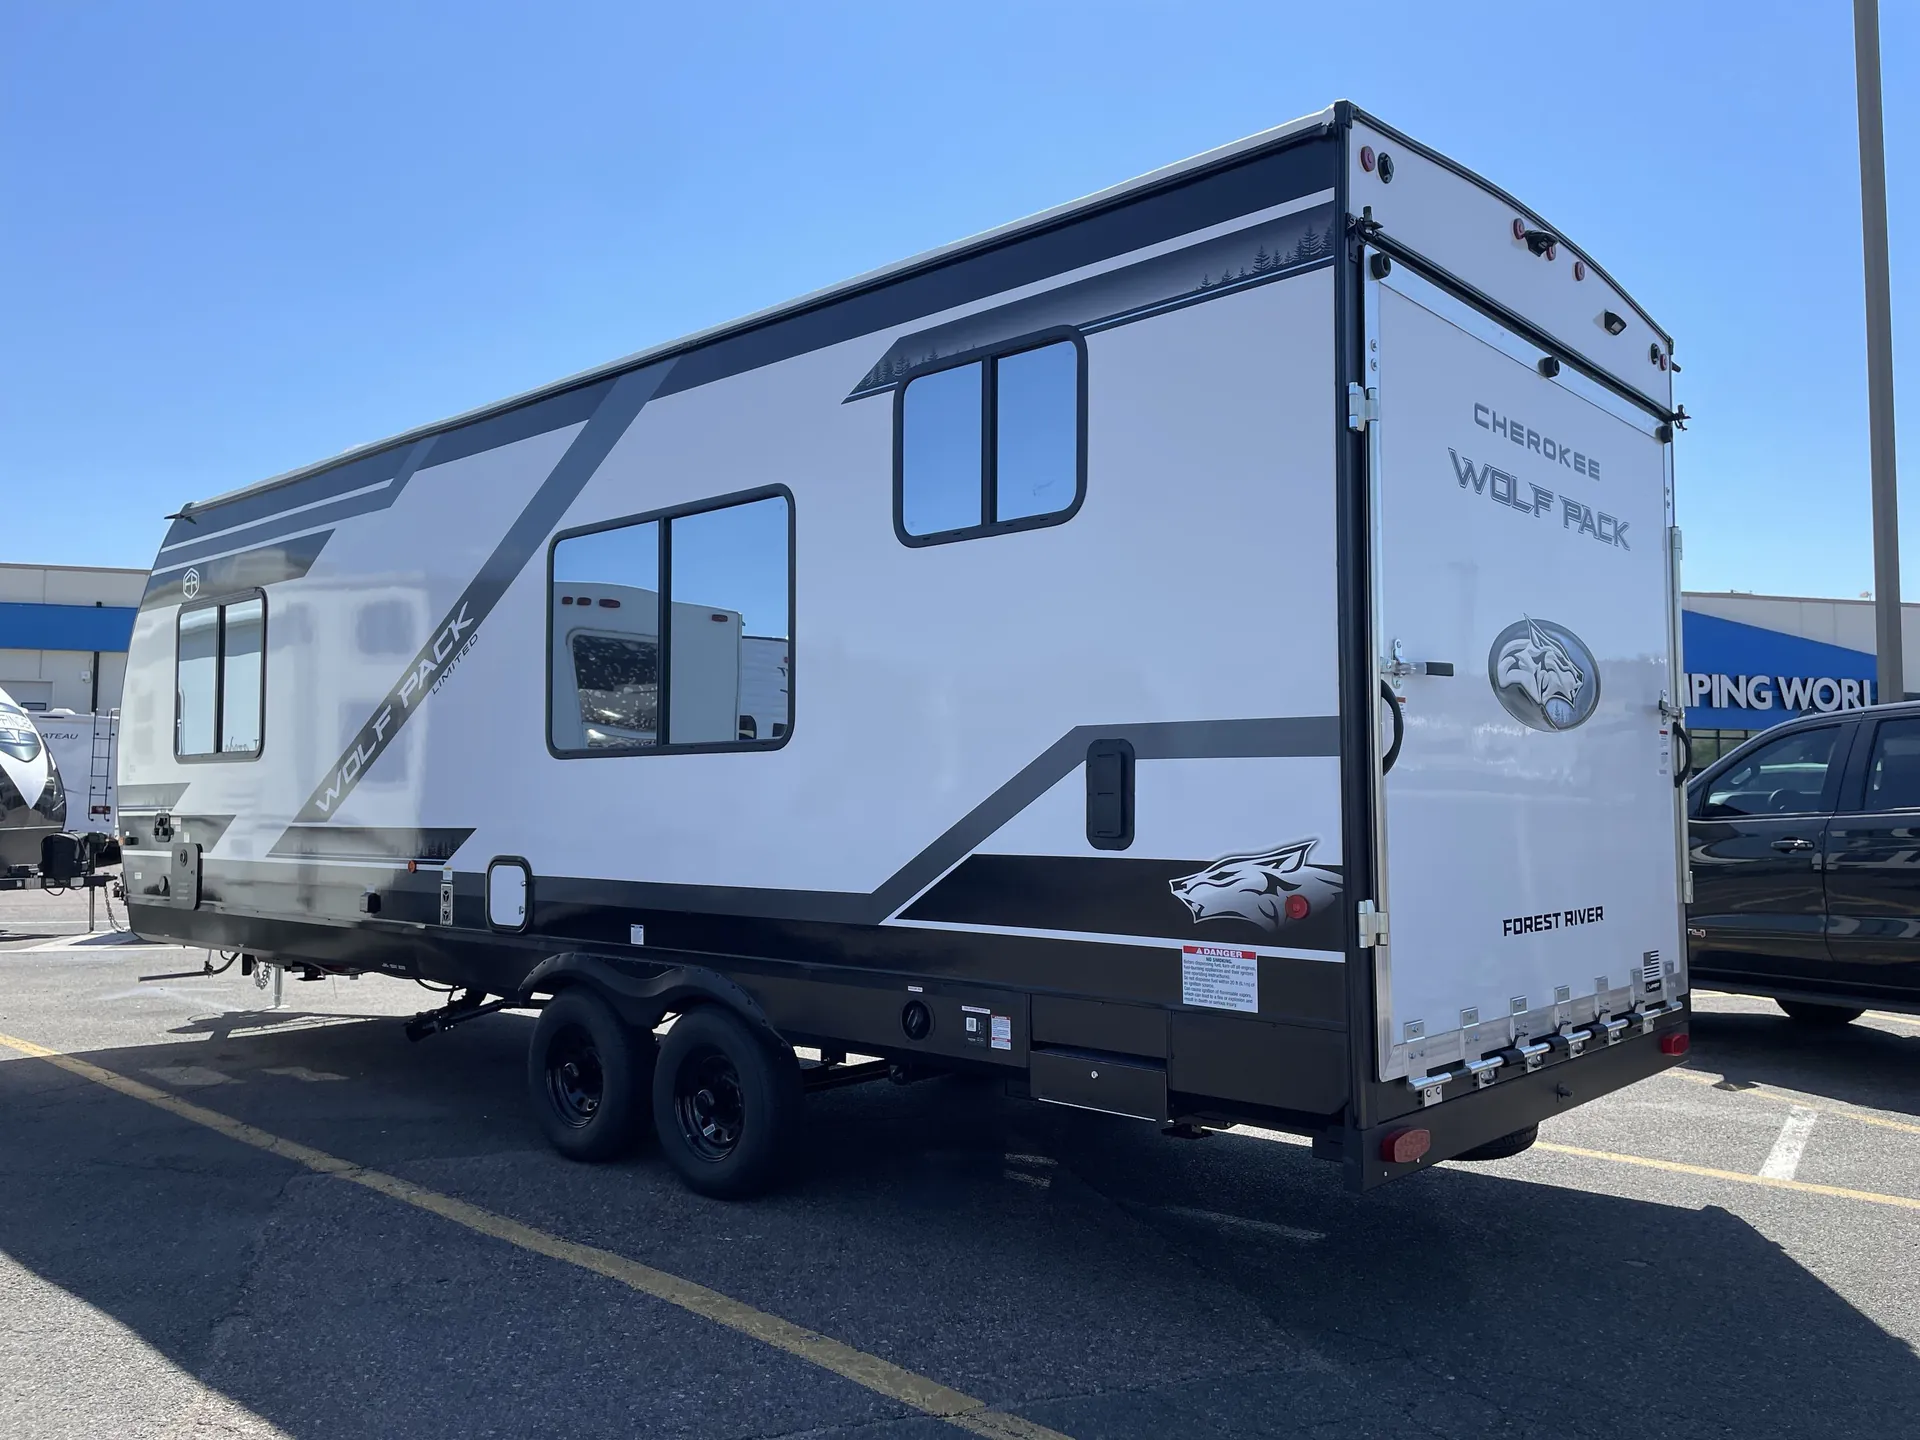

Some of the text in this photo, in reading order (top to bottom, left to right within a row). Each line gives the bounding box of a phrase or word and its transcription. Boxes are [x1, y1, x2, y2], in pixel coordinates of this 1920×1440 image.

[1474, 402, 1600, 481] CHEROKEE
[1448, 447, 1631, 551] WOLF PACK
[432, 633, 478, 695] LIMITED
[315, 601, 474, 812] WOLF PACK
[1204, 949, 1243, 958] DANGER
[1503, 906, 1604, 936] FOREST RIVER
